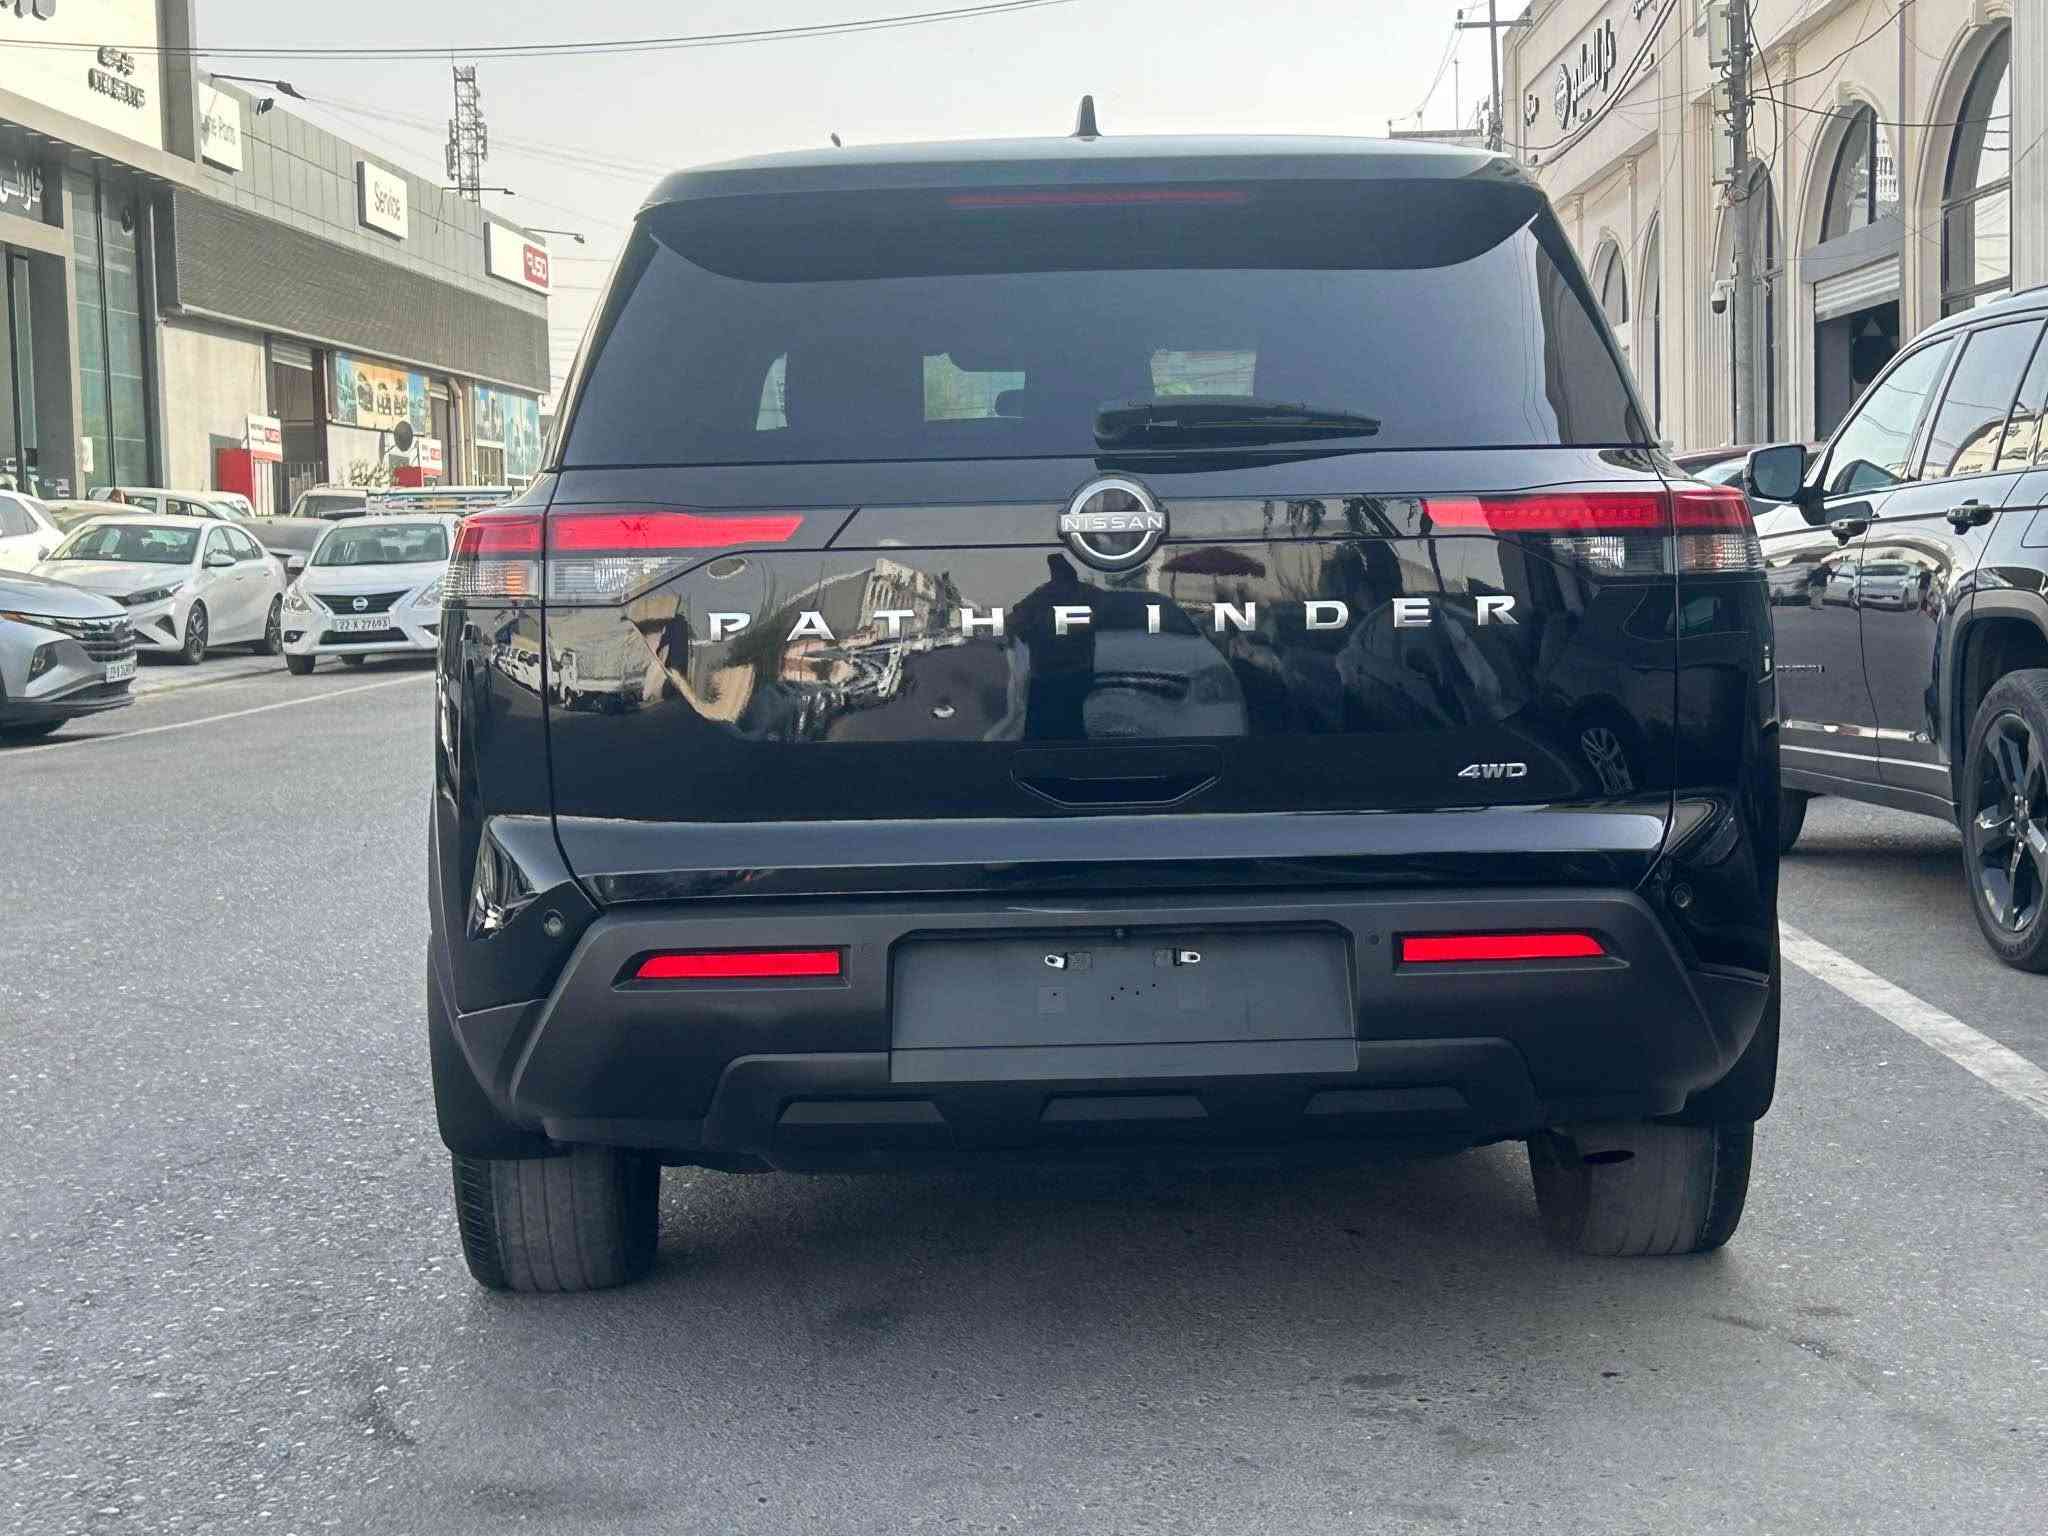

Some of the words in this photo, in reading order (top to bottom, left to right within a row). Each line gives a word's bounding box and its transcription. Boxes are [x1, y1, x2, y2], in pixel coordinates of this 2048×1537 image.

[1063, 515, 1162, 530] NISSAN
[707, 595, 1519, 641] PATHFINDER
[1457, 762, 1527, 778] 4WD
